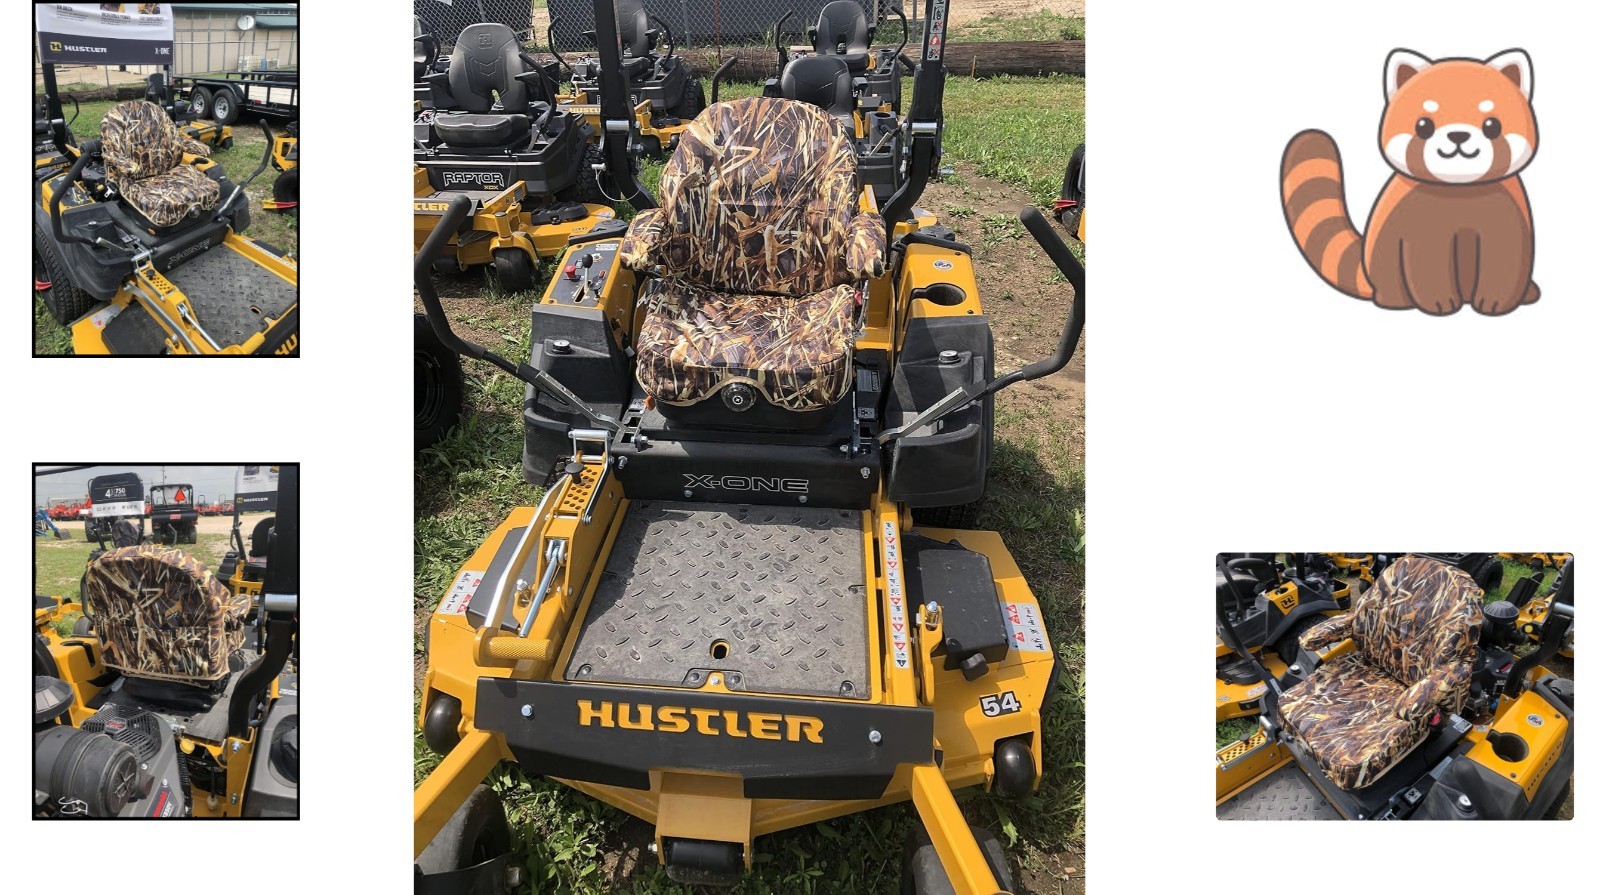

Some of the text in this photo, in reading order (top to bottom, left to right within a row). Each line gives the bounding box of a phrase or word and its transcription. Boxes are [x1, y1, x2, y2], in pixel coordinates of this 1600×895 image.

[64, 44, 108, 53] HUSTLER
[154, 47, 170, 55] X-ONE
[442, 171, 505, 188] RAPTOR
[682, 472, 809, 494] X-ONE
[982, 692, 1021, 717] 54
[577, 699, 824, 744] HUSTLER
